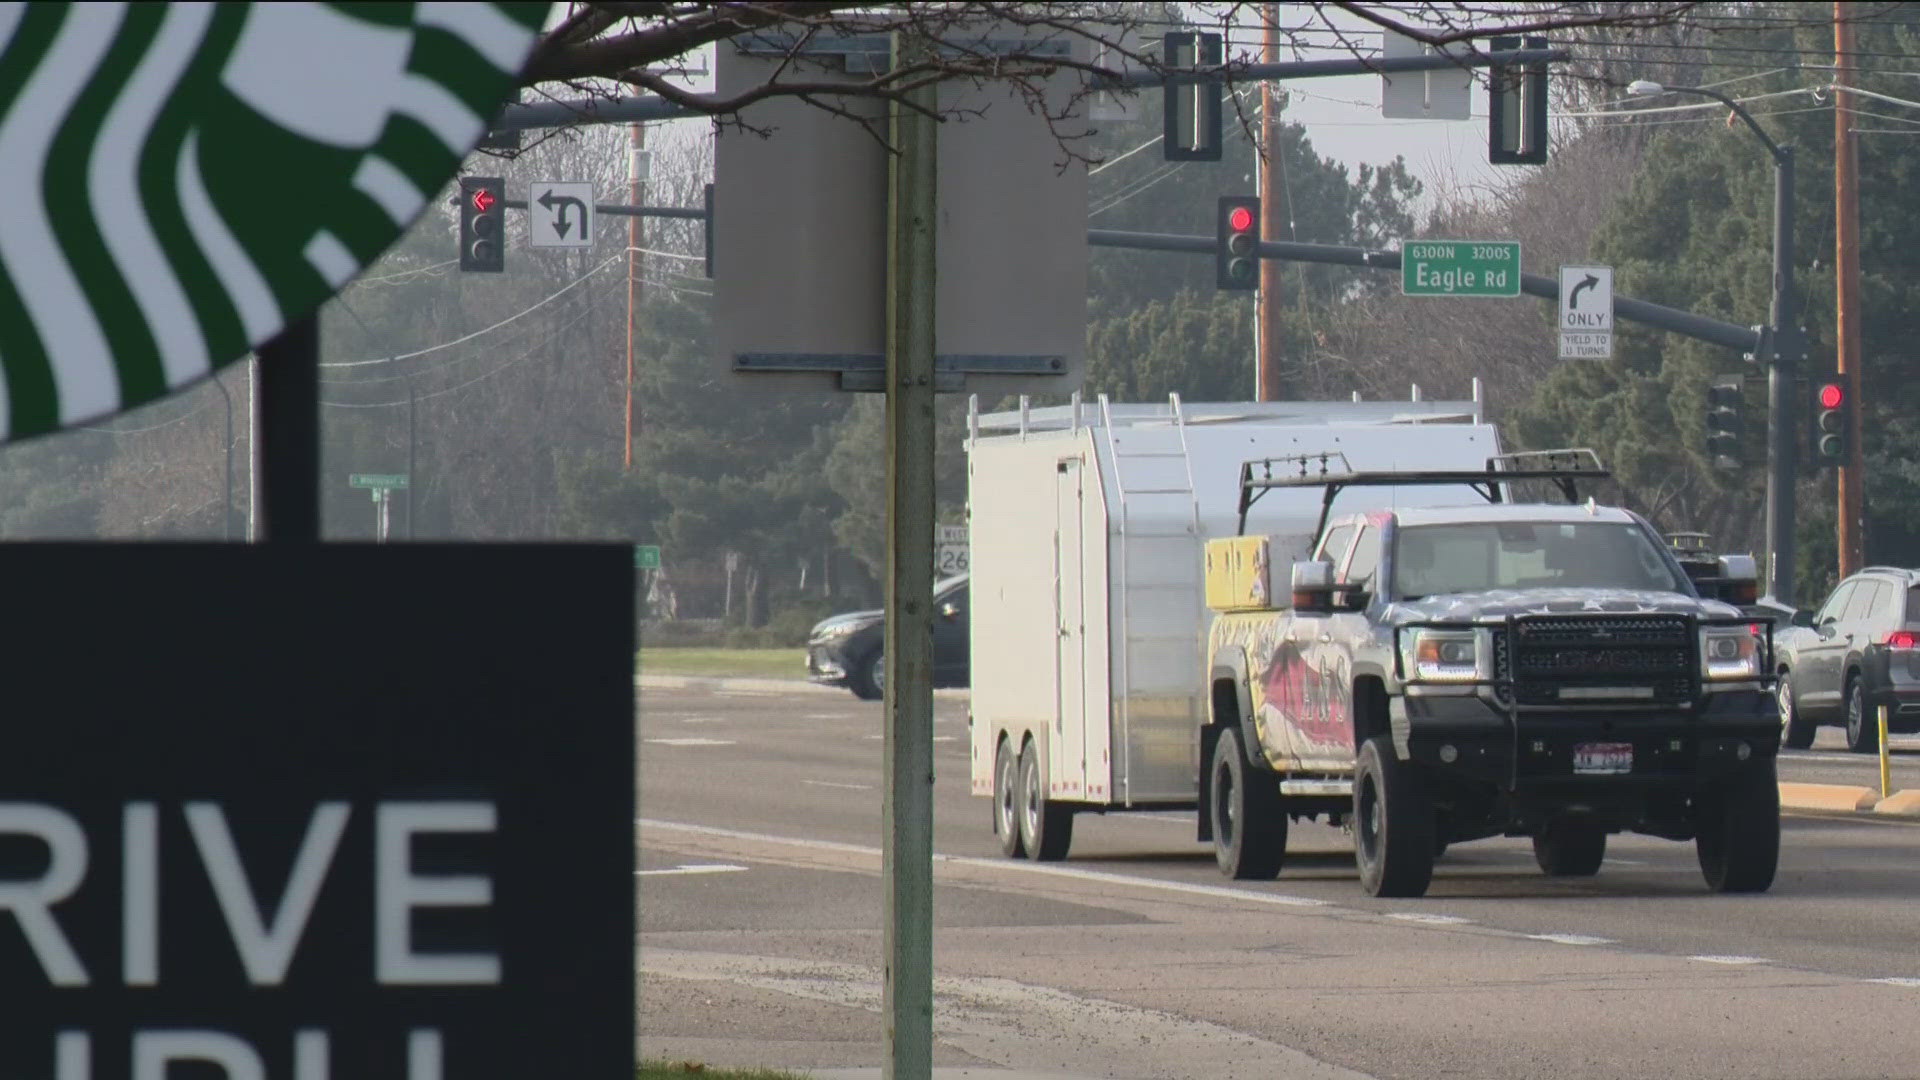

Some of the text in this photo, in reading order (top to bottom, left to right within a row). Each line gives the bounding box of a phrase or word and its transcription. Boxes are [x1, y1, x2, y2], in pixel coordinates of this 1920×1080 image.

[1413, 245, 1511, 260] 6300N 3200S
[1417, 262, 1506, 292] Eagle Rd
[1567, 313, 1605, 326] ONLY
[1565, 335, 1607, 345] YIELD TO
[1577, 346, 1606, 356] TURNS
[943, 551, 968, 570] 26
[0, 801, 502, 987] RIVE
